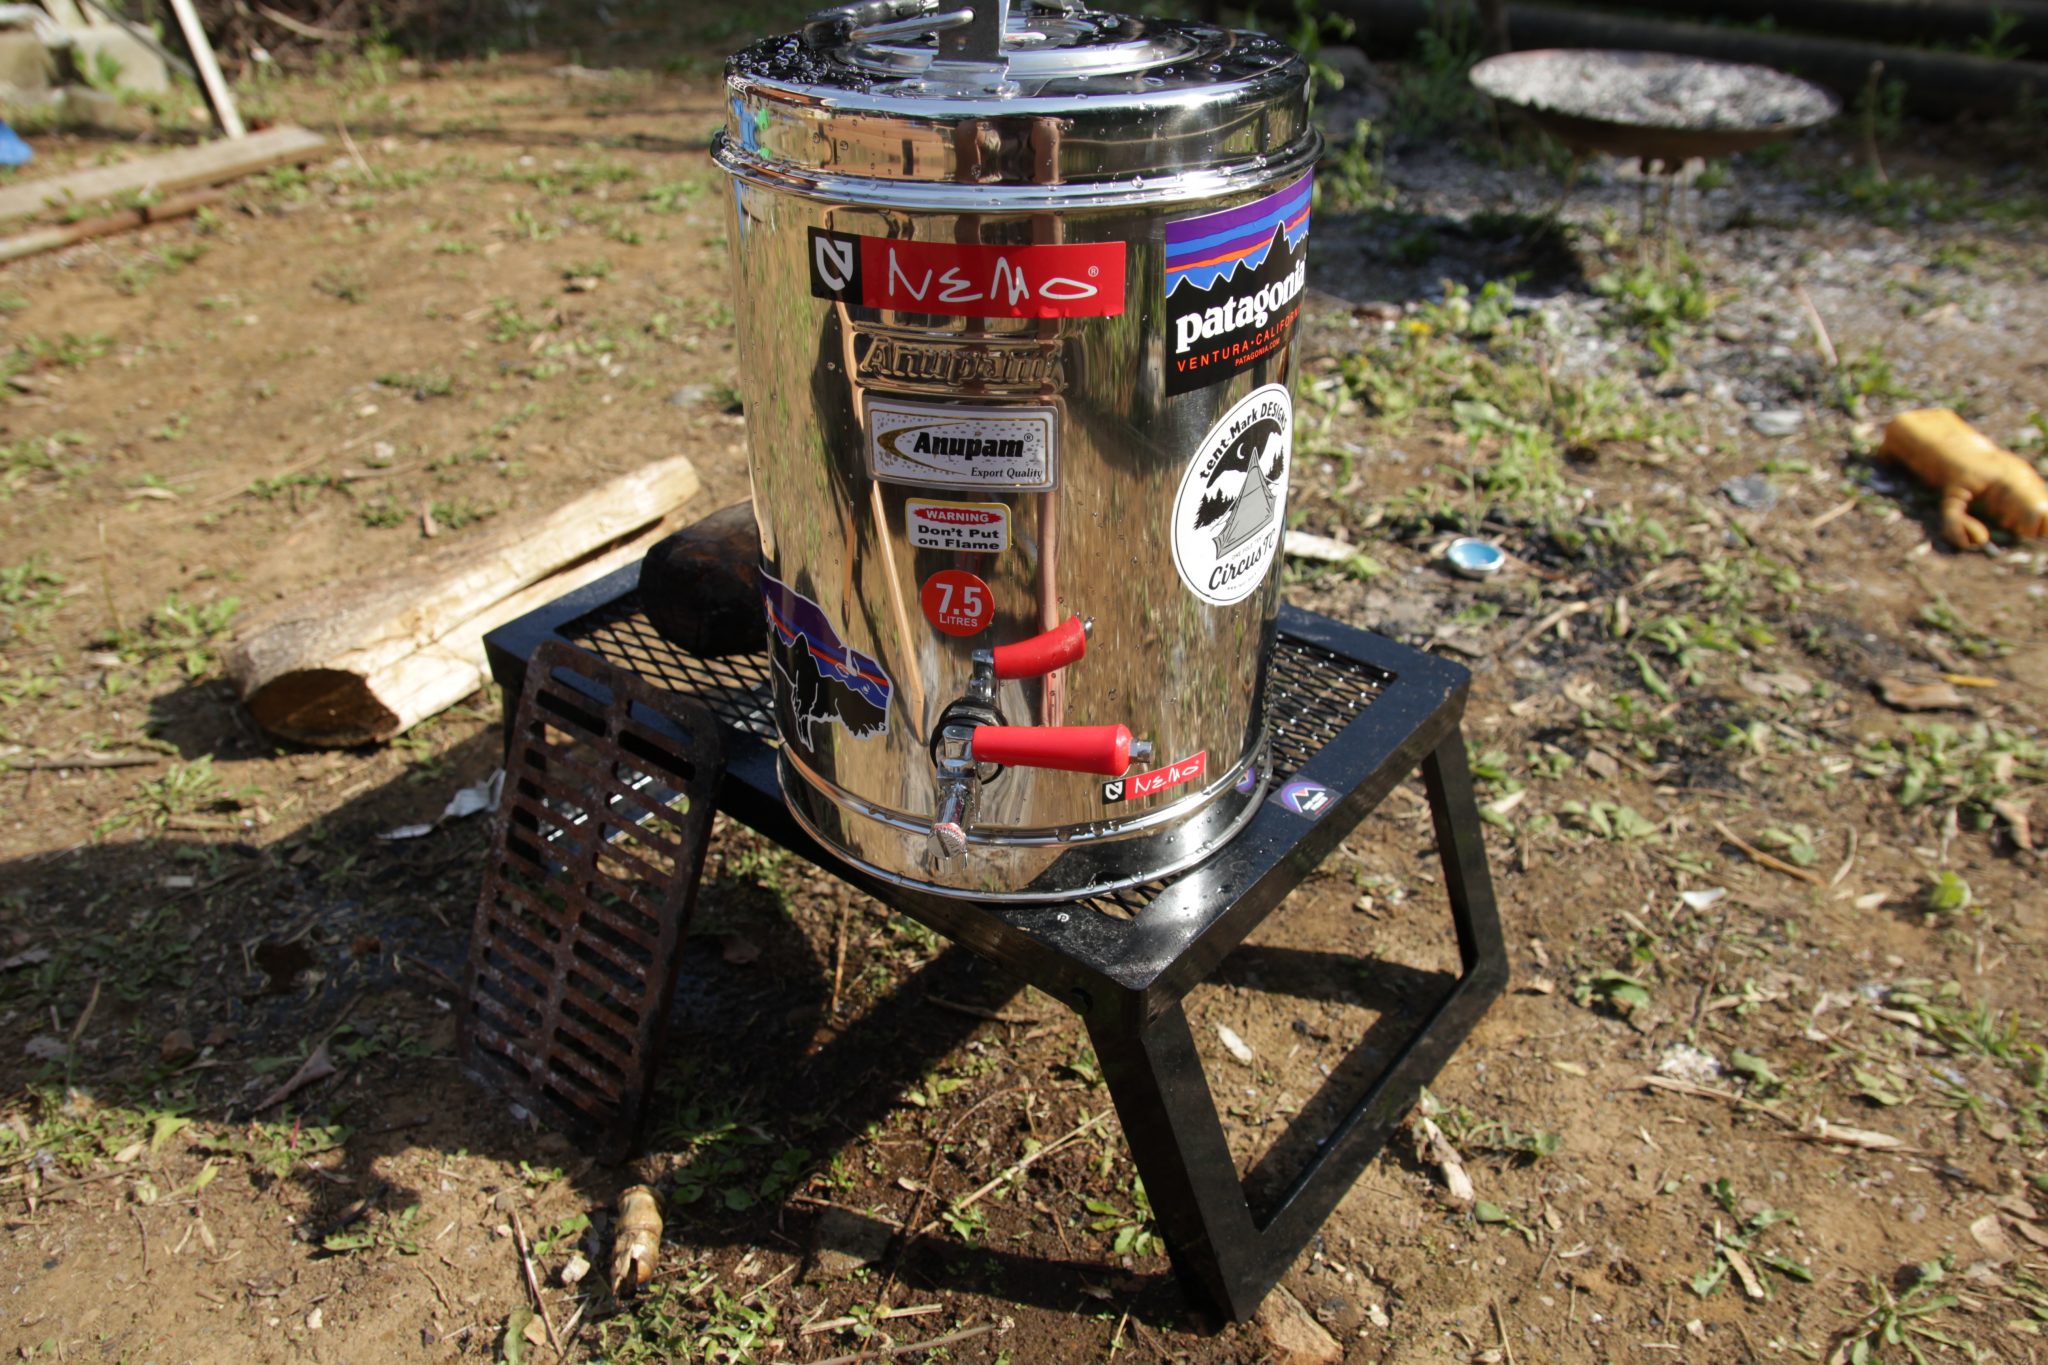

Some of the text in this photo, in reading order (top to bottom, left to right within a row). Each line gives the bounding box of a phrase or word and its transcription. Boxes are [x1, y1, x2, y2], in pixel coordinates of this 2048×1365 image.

[913, 431, 1025, 461] Anupam
[970, 467, 1043, 479] Export Quality
[926, 509, 990, 523] WARNING
[917, 525, 1000, 539] Don't Put
[917, 537, 1000, 550] on Flame
[1208, 546, 1262, 590] Circus
[936, 583, 983, 617] 7.5
[939, 613, 978, 627] LITRES
